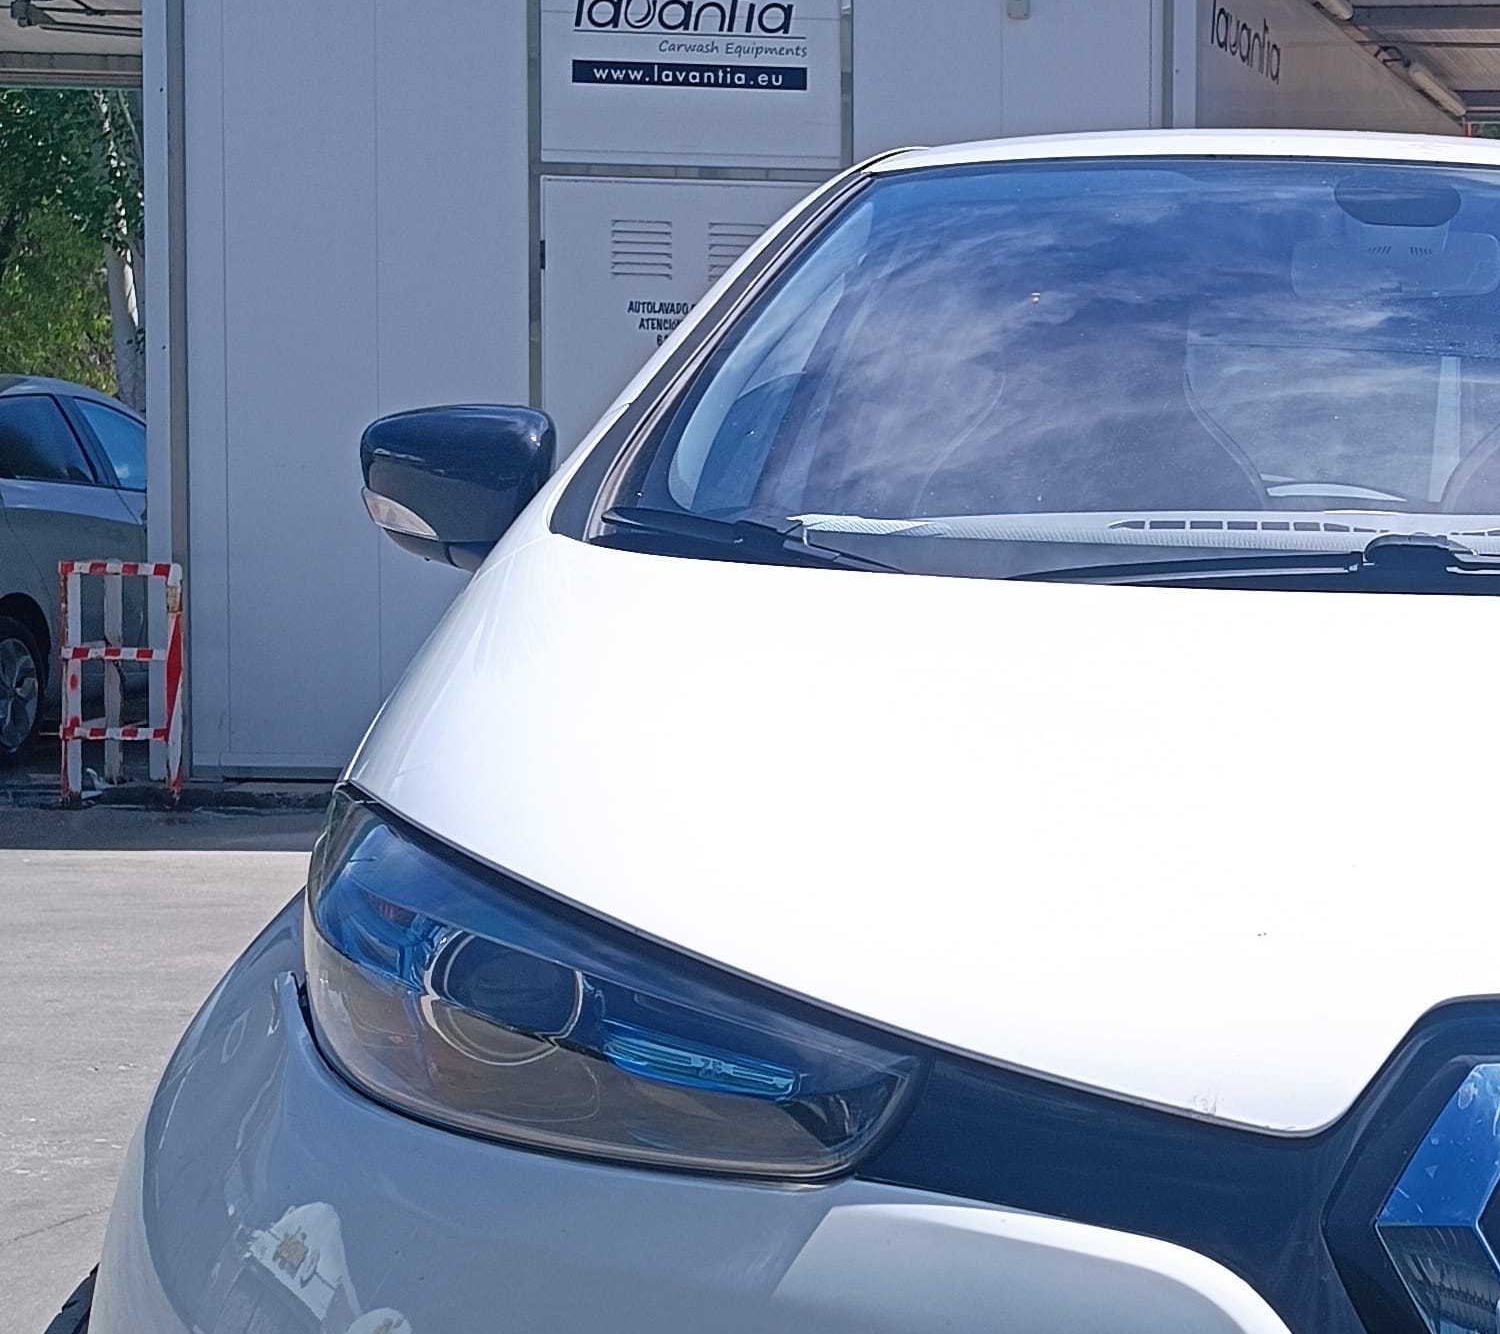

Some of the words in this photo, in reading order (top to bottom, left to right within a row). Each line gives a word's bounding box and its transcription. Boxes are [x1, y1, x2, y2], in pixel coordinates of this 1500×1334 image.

[659, 39, 719, 54] Carwash
[725, 42, 808, 59] Equipments
[593, 65, 784, 86] www.lavantia.eu
[627, 300, 689, 315] AUTOLAVADO
